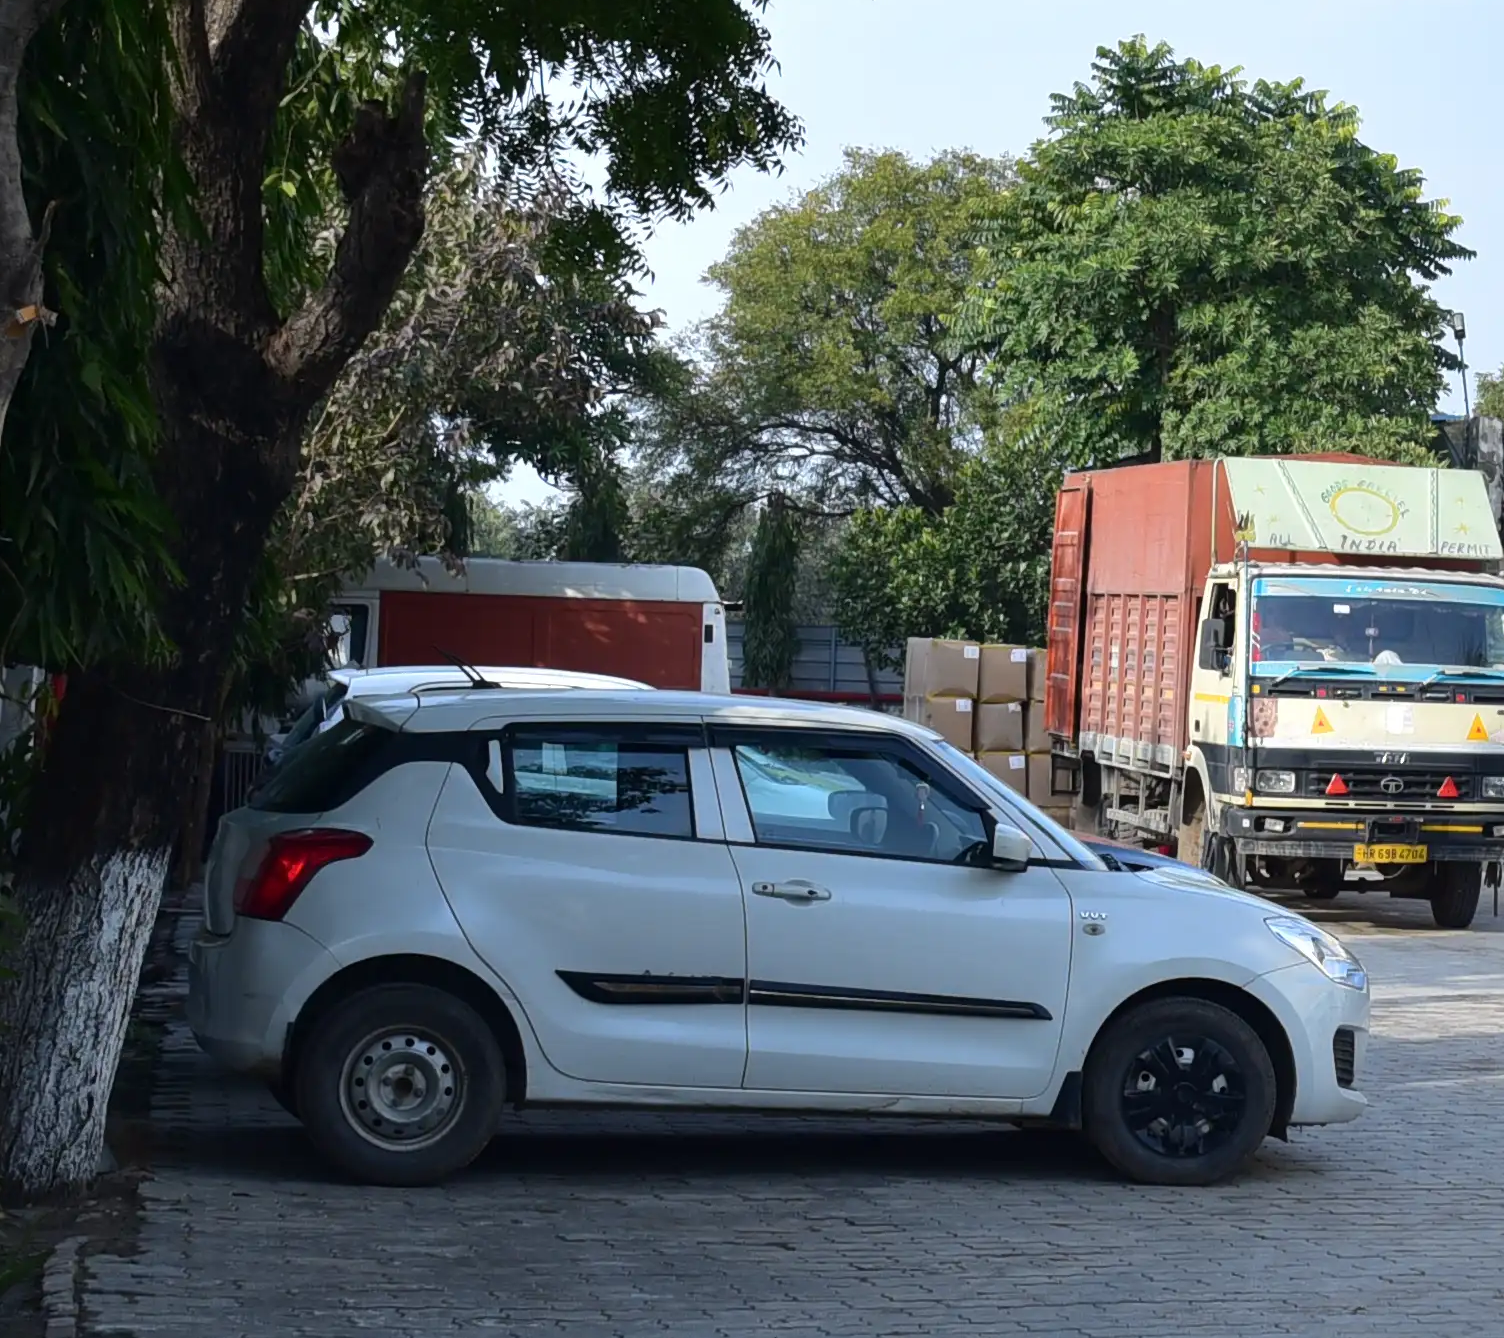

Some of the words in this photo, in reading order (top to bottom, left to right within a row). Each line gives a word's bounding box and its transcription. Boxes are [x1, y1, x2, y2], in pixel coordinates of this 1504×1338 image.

[1340, 534, 1397, 553] INDIA
[1441, 541, 1491, 555] PERMIT
[1363, 848, 1376, 859] HR
[1399, 848, 1425, 859] 4704
